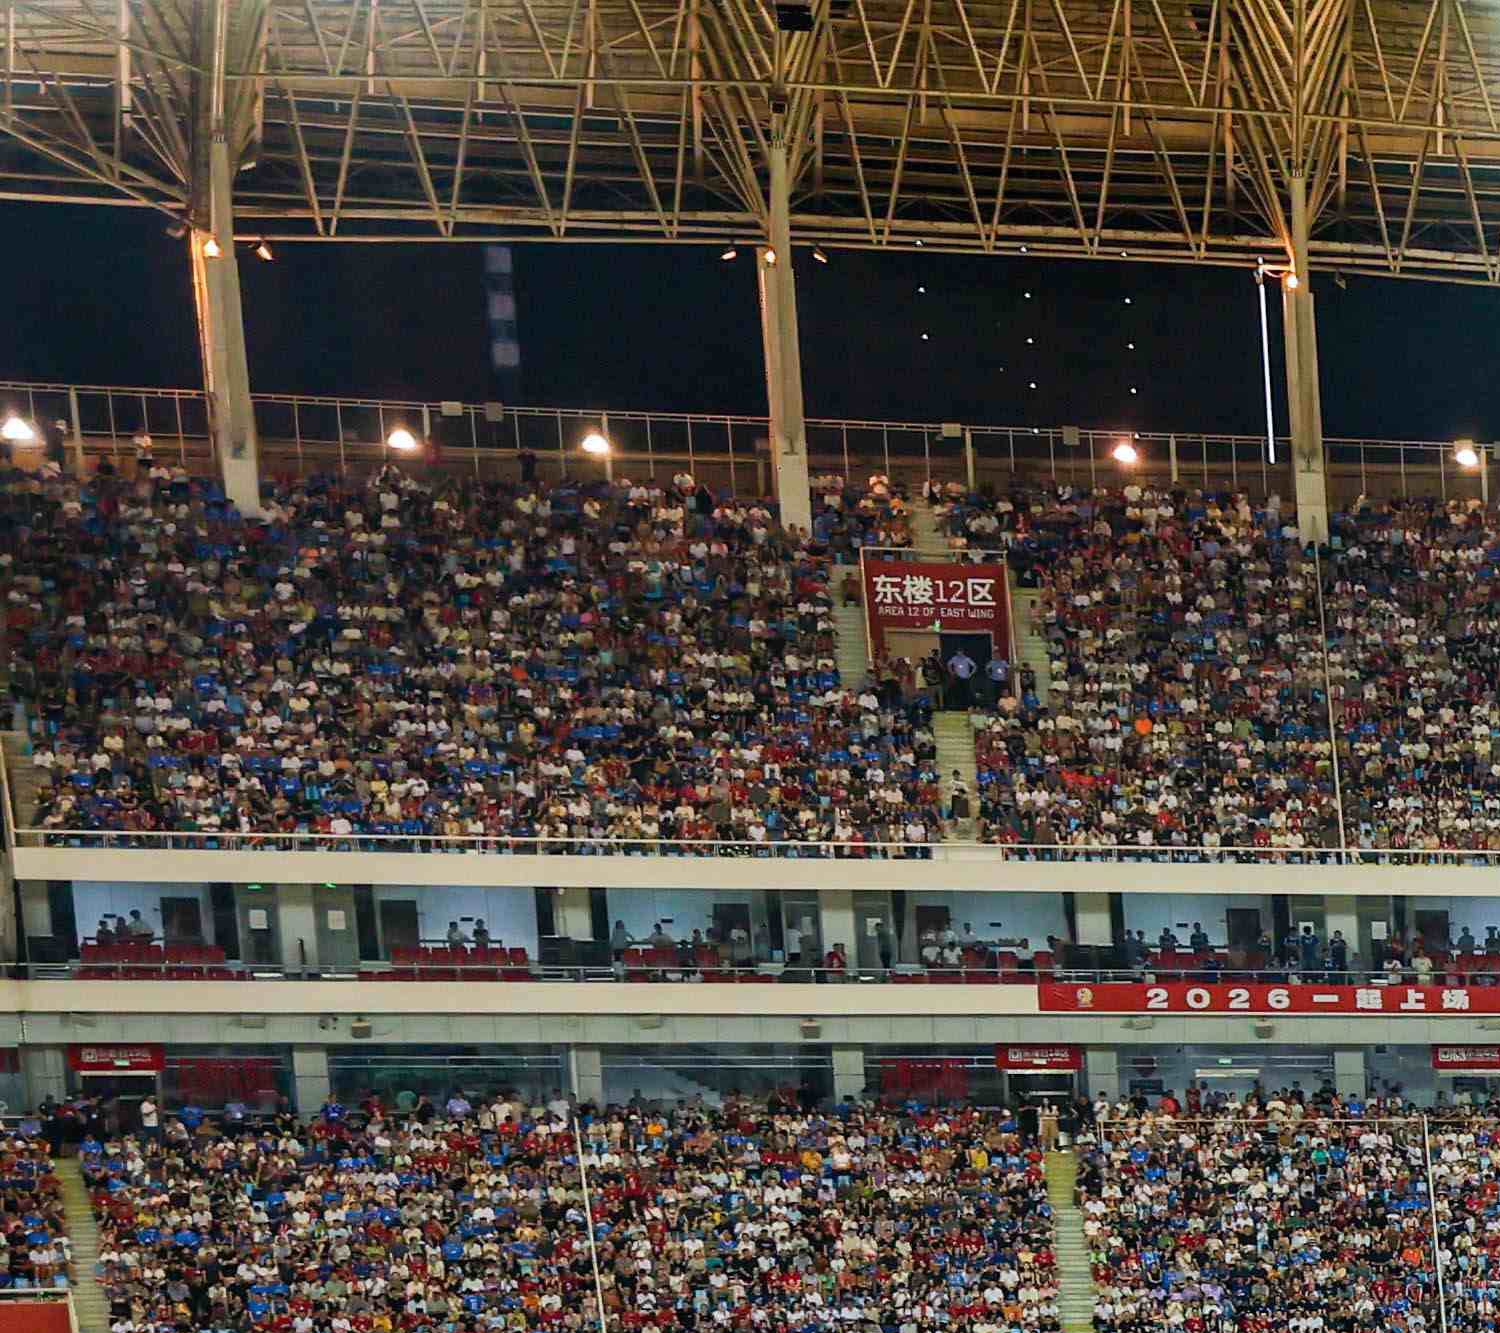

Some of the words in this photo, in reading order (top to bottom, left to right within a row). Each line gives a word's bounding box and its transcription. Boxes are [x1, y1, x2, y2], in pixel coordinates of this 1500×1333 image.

[873, 575, 996, 605] 东楼12区
[878, 606, 904, 615] AREA
[908, 607, 918, 616] 12
[923, 607, 935, 616] OF
[940, 608, 965, 617] EAST
[968, 609, 994, 619] WING
[1146, 986, 1470, 1010] 2026一起上场
